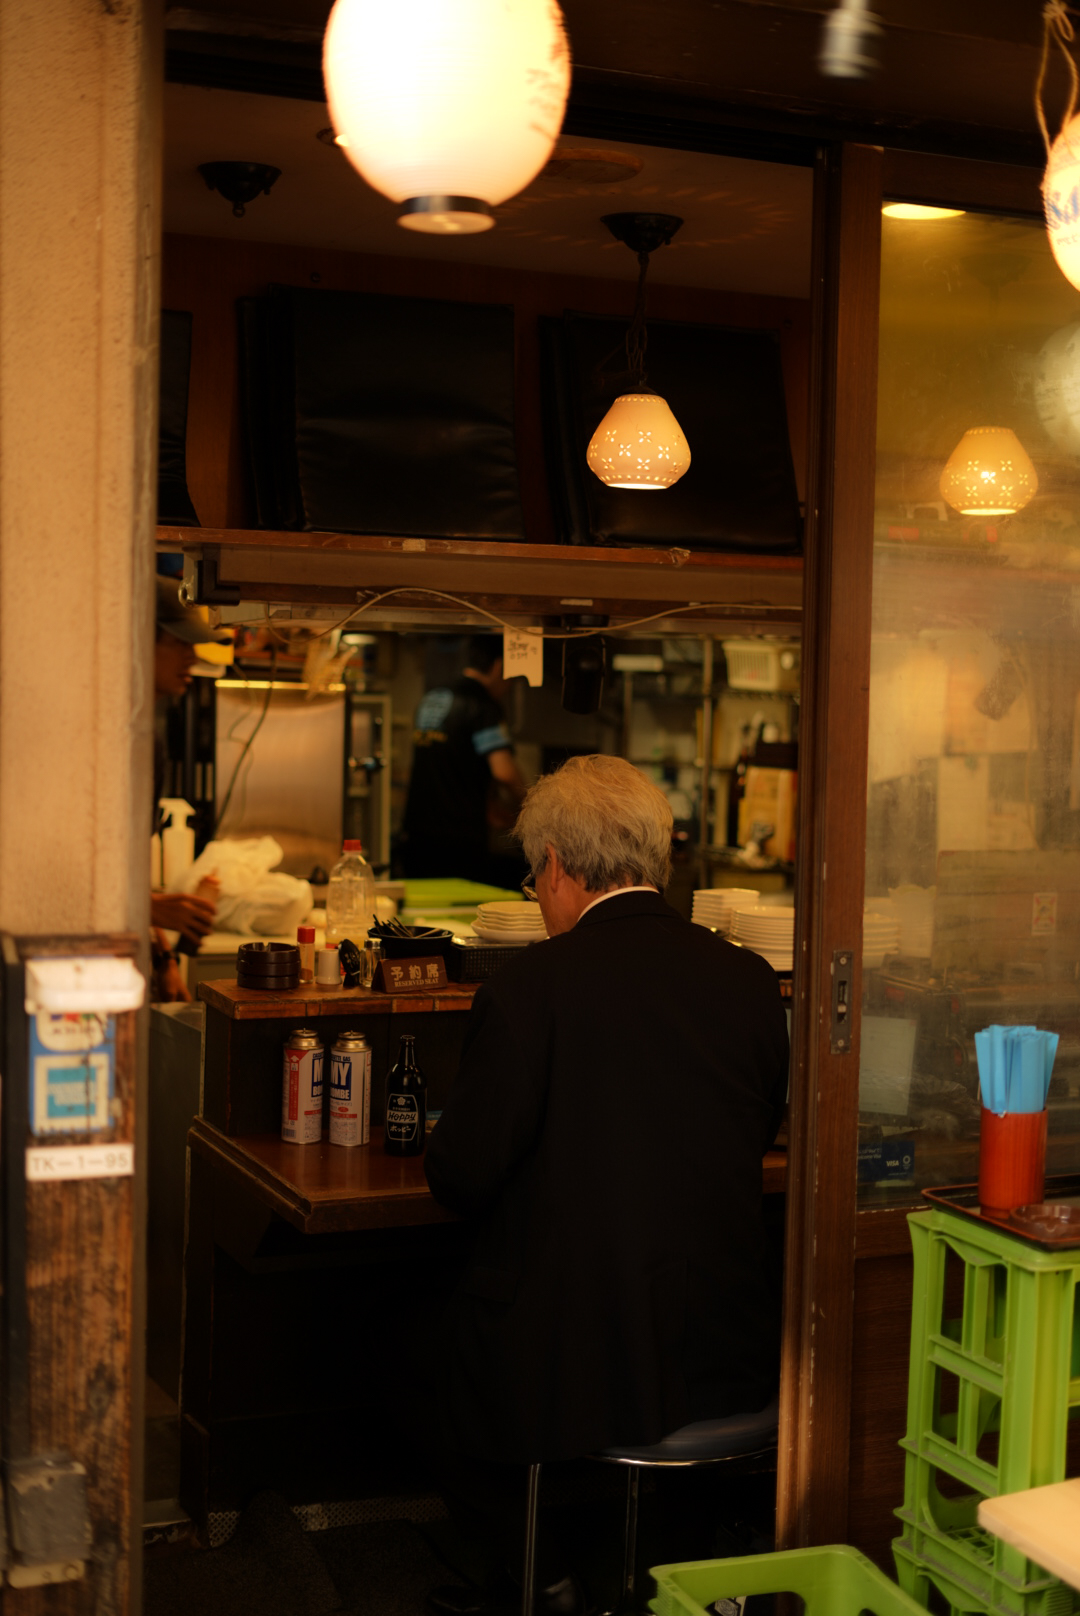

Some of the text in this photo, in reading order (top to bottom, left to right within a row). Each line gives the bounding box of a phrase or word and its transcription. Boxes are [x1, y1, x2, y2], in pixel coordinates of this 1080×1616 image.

[391, 963, 439, 981] 予約席
[394, 979, 424, 987] RESERVED
[331, 1061, 350, 1086] MY
[390, 1124, 411, 1132] ホッピー
